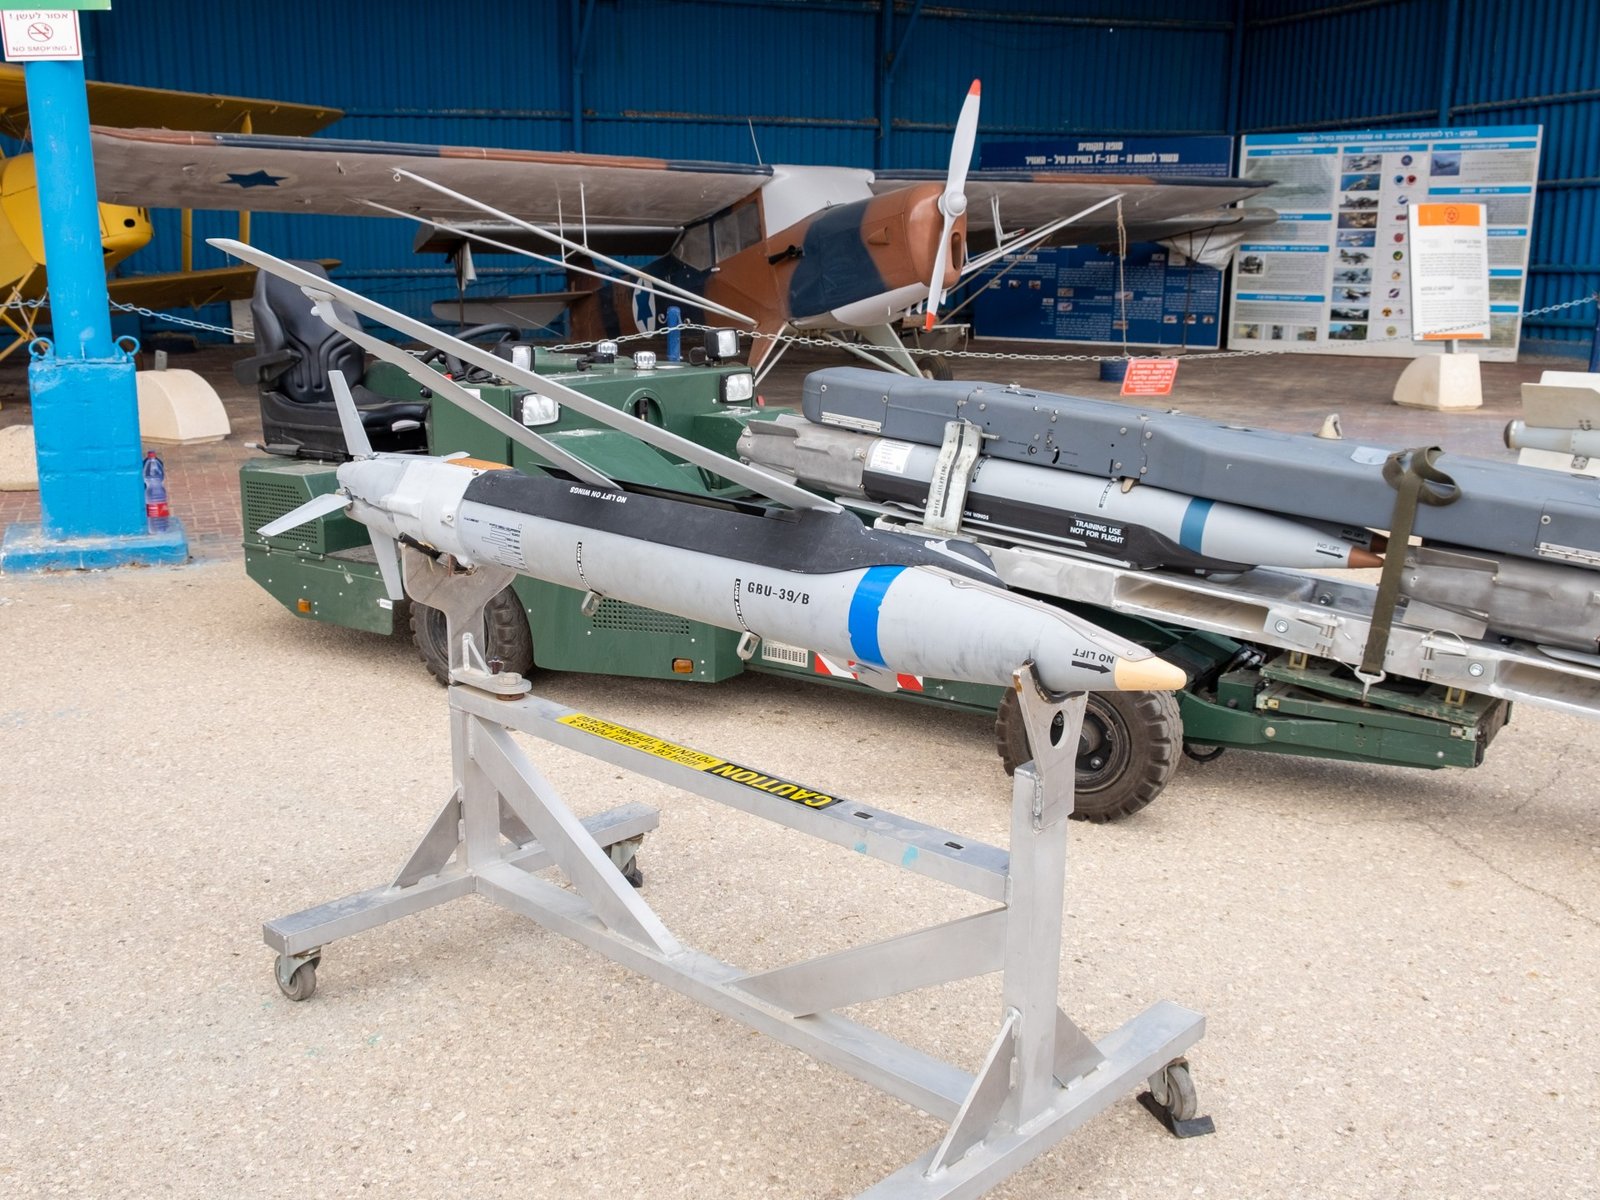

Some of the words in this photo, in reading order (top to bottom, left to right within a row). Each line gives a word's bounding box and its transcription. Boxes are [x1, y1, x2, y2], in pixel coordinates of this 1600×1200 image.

[569, 486, 591, 496] WINGS
[601, 493, 616, 501] LIFT
[1070, 526, 1084, 535] NOT
[1085, 529, 1100, 538] FOR
[1101, 533, 1124, 544] FLIGHT
[1075, 520, 1107, 532] TRAINING
[1108, 527, 1122, 535] USE
[747, 581, 810, 605] GBU-39/B
[1072, 648, 1096, 660] LIFT
[1099, 653, 1115, 664] NO
[577, 715, 618, 733] HAZARD
[611, 733, 640, 745] CART
[618, 729, 659, 745] TIPPING
[659, 742, 715, 763] POTENTIAL
[670, 754, 701, 766] HIGH
[712, 764, 832, 807] CAUTION
